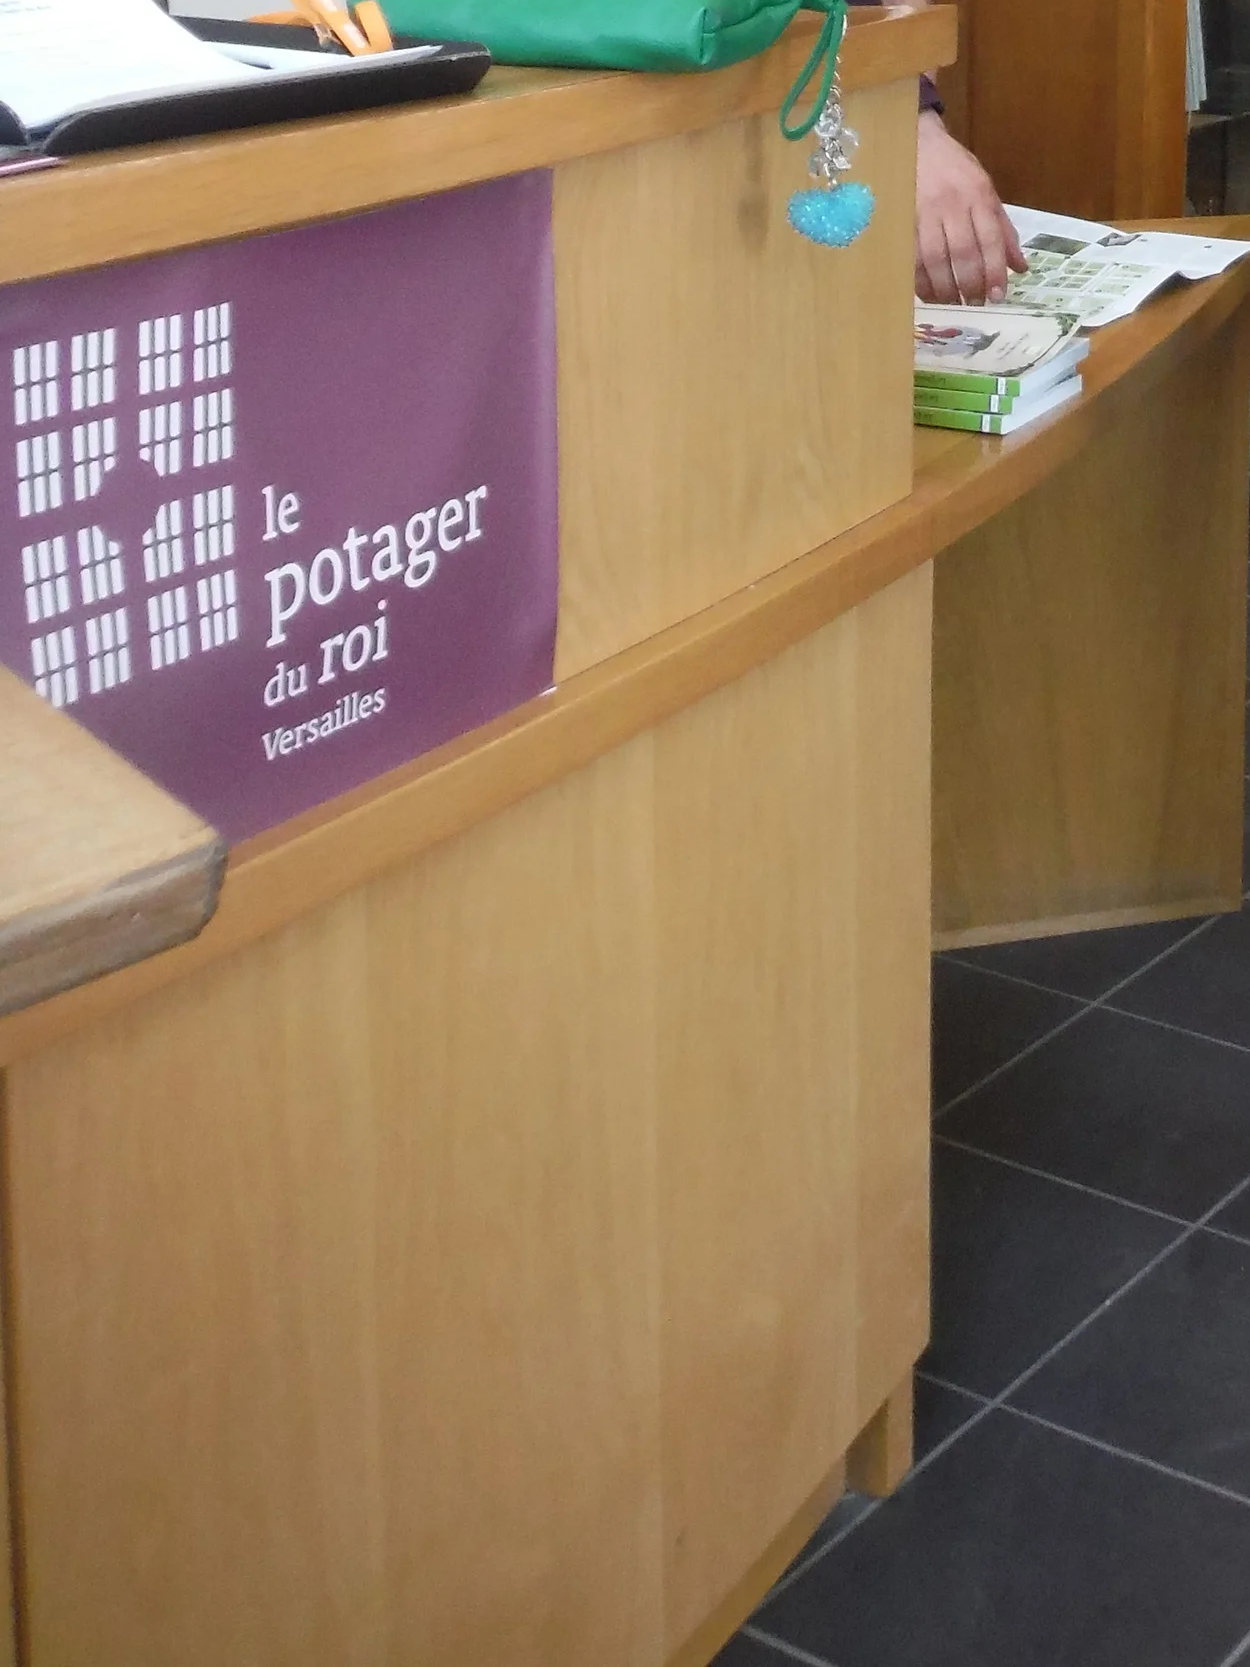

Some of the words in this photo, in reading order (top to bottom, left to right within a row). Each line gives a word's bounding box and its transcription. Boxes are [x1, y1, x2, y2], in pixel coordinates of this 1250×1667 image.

[260, 484, 301, 541] le
[263, 485, 488, 648] potager
[263, 661, 308, 707] du
[317, 598, 388, 684] roi
[261, 687, 387, 761] Versailles
